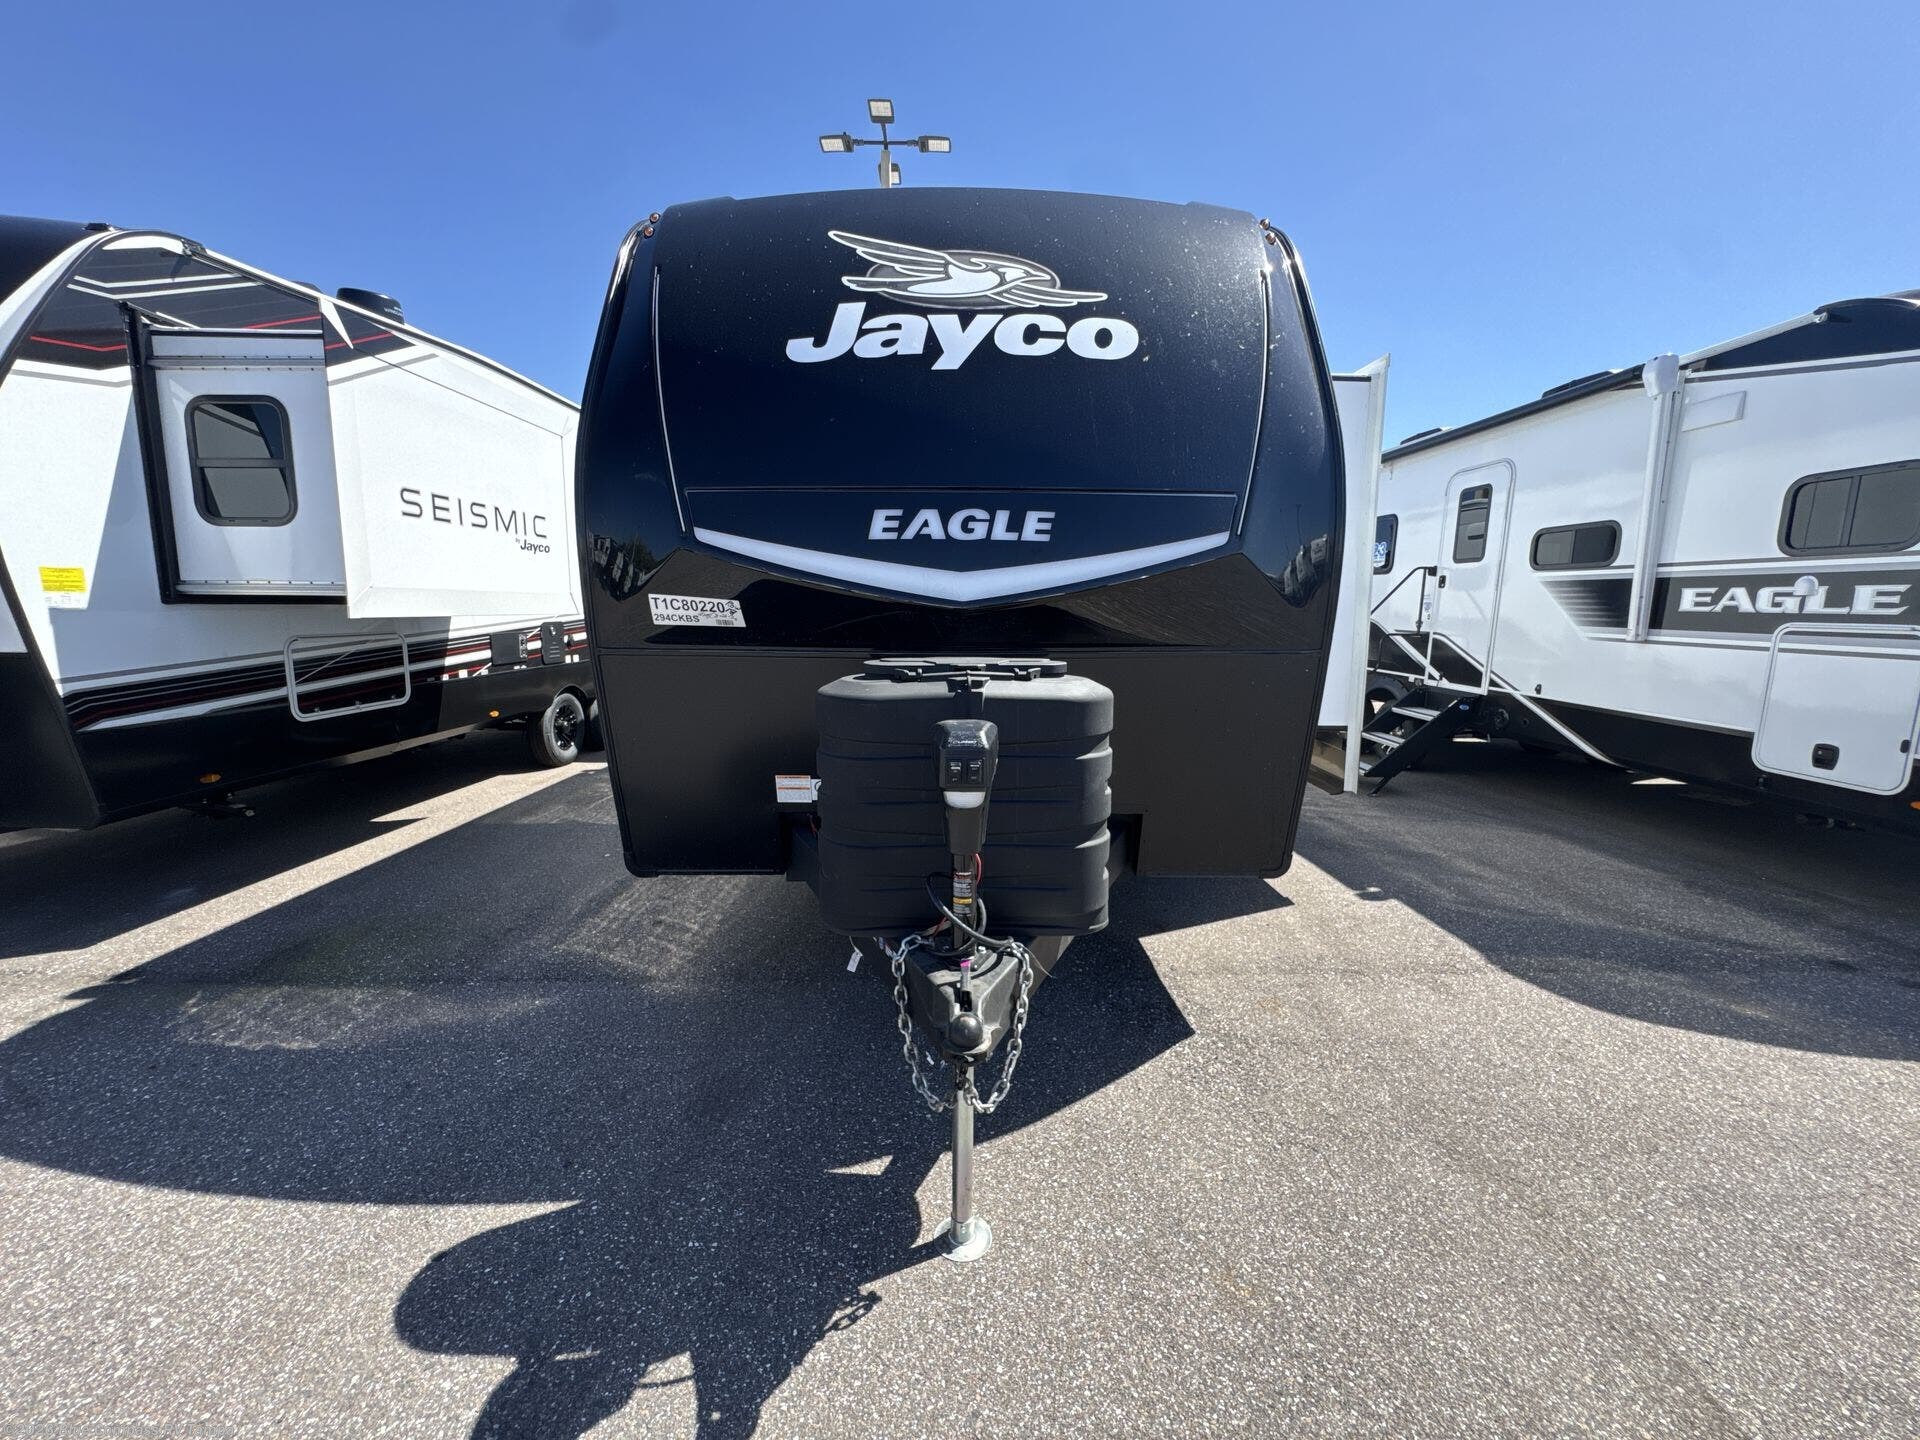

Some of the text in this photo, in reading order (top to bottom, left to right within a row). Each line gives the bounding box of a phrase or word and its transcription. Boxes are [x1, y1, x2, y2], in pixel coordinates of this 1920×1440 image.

[786, 302, 1139, 370] Jayco
[400, 488, 547, 539] SEISMIC
[868, 509, 1056, 542] EAGLE
[520, 539, 550, 555] Jayco
[651, 597, 725, 613] T1C80220
[1678, 584, 1912, 615] EAGLE
[654, 613, 700, 623] 294CKBS
